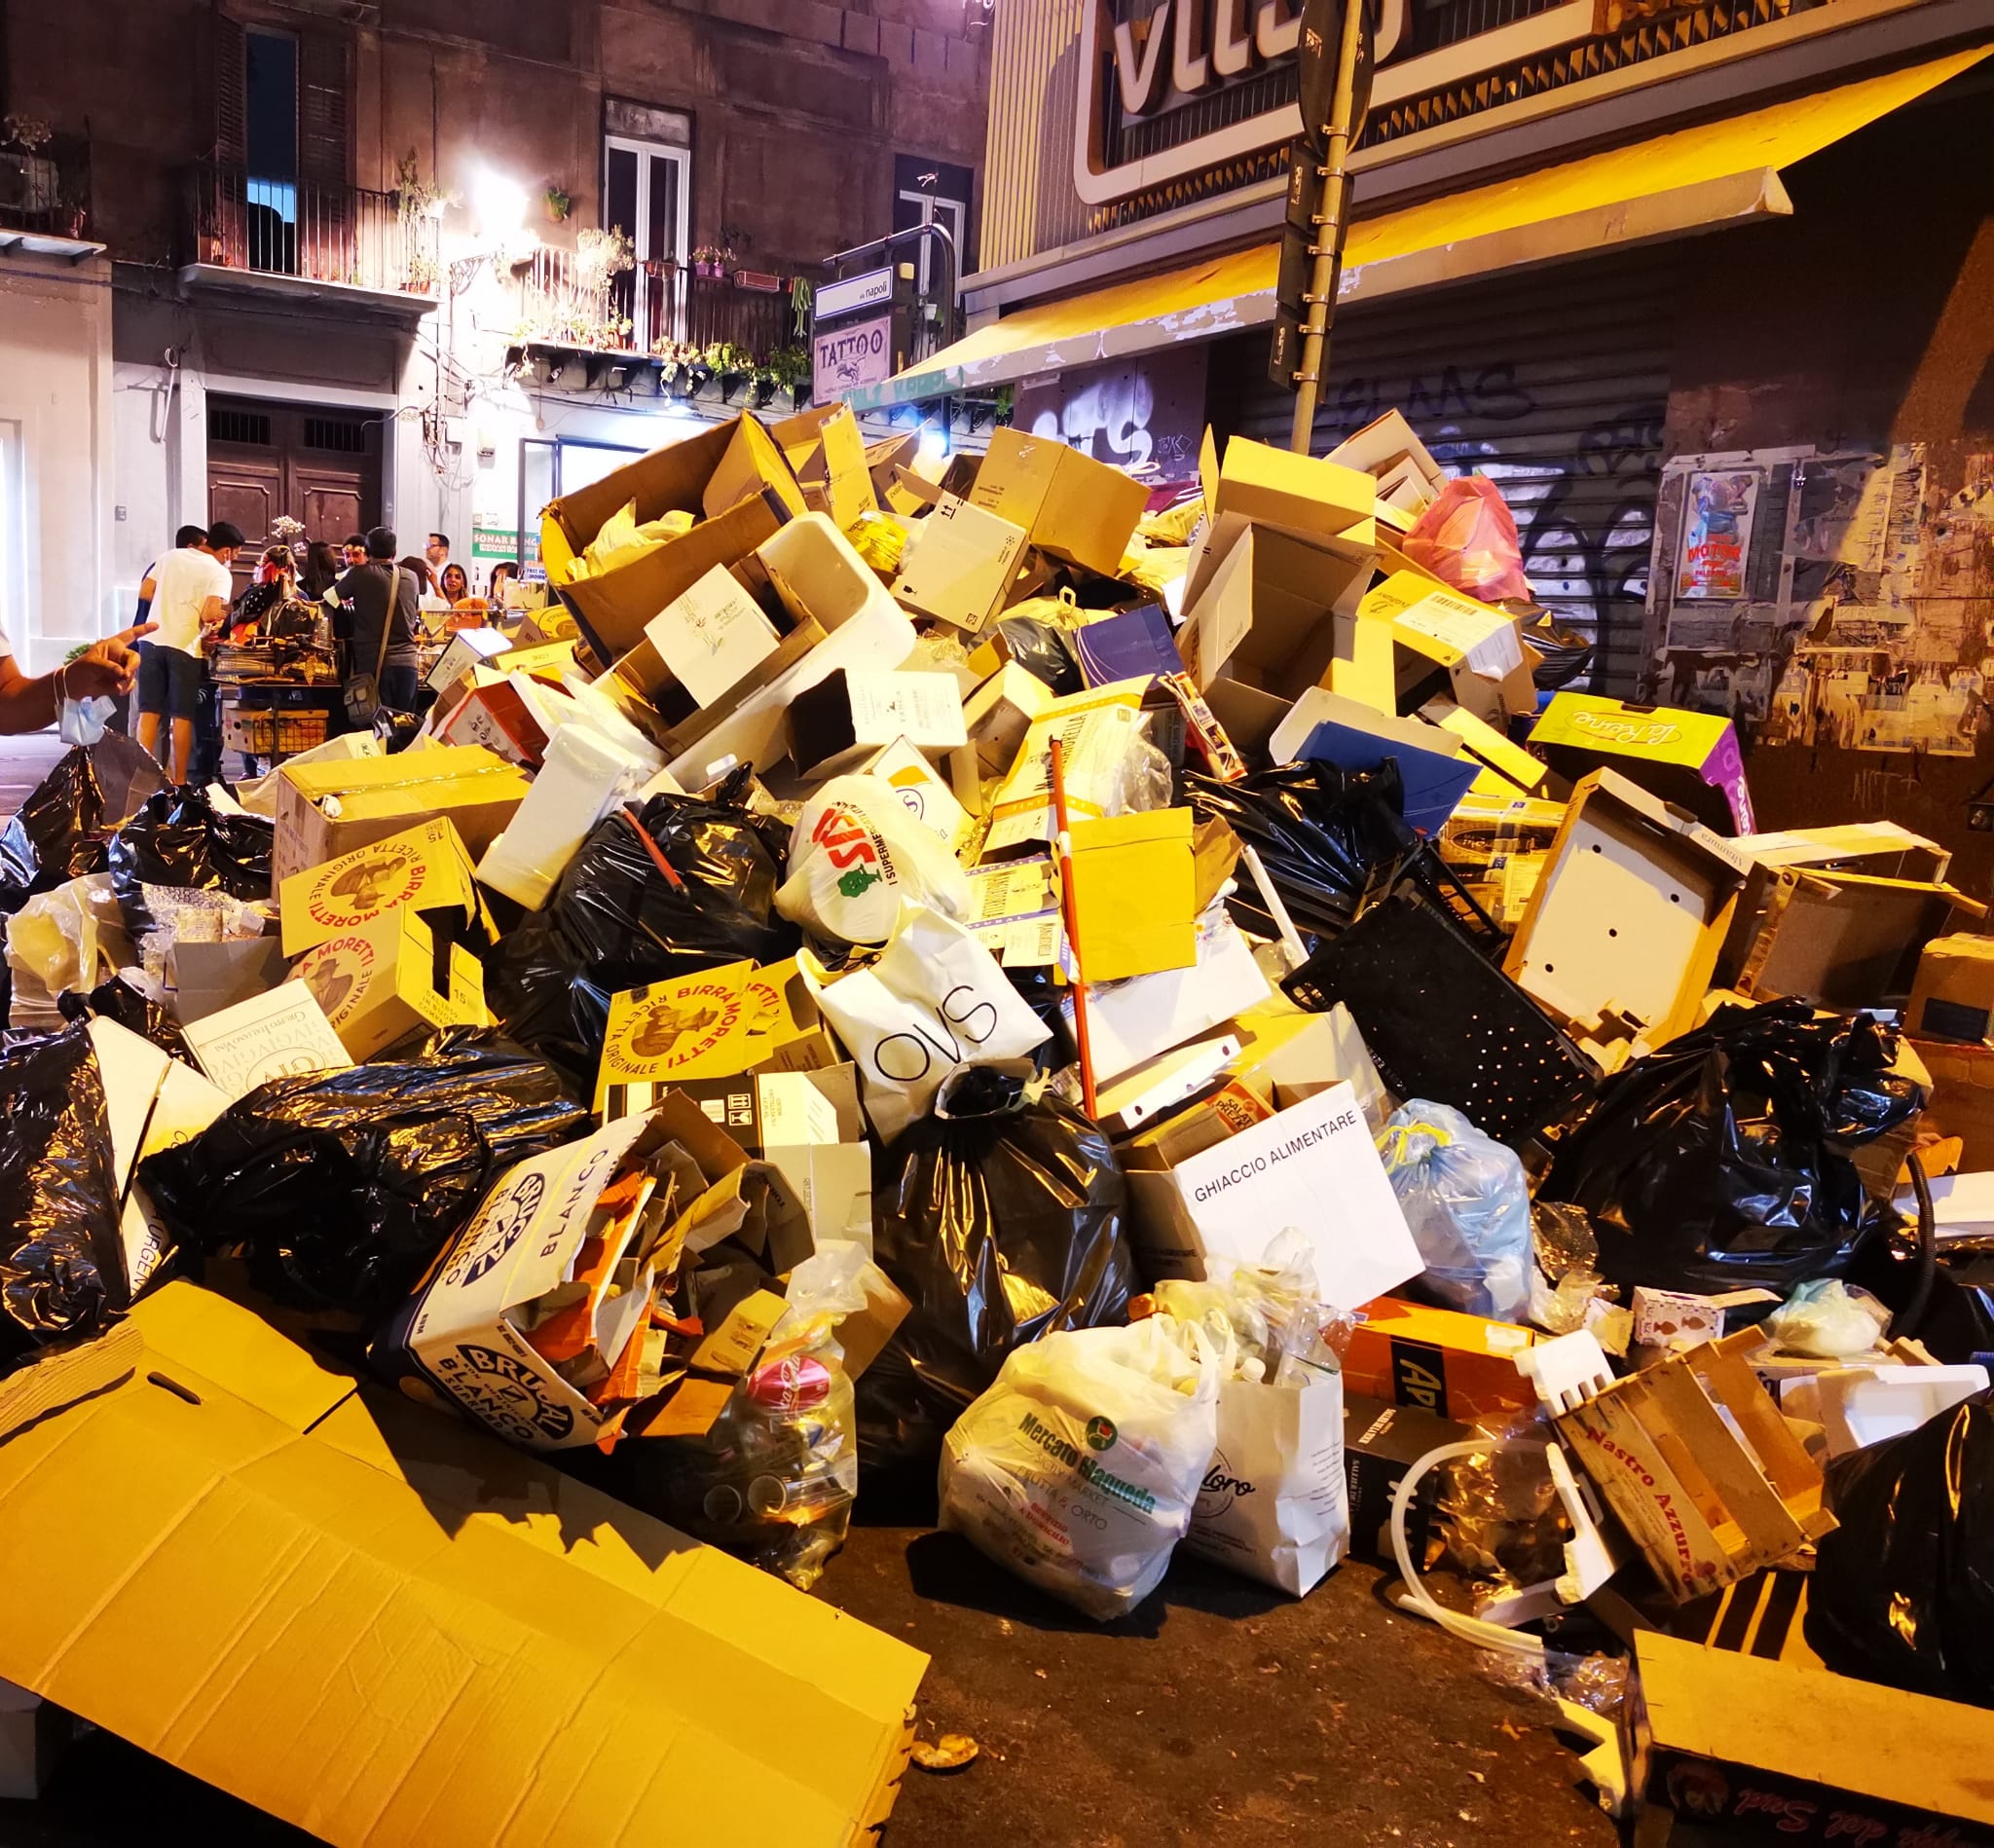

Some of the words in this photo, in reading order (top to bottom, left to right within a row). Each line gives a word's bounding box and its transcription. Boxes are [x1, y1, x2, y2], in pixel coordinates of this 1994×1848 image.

[866, 281, 887, 298] napoli
[820, 329, 883, 369] TATTOO
[474, 534, 505, 544] SONAR
[1687, 544, 1742, 563] MOTOR
[1572, 711, 1644, 743] Reine
[1647, 723, 1678, 745] La
[372, 843, 422, 864] RICETTA
[428, 832, 444, 843] 15
[309, 850, 366, 902] ORIGINALE
[384, 865, 426, 909] BIRRA
[309, 902, 380, 929] MORETTI
[316, 937, 375, 967] MORETTI
[454, 989, 467, 1005] 15
[678, 984, 737, 1003] BIRRA
[747, 982, 780, 1007] ETTI
[610, 995, 668, 1042] RICETTA
[668, 1001, 742, 1069] MORETTI
[874, 985, 997, 1082] OVS
[606, 1044, 660, 1075] ORIGINALE
[1217, 1101, 1247, 1130] PREZIO
[1225, 1098, 1253, 1126] SALAT
[1195, 1157, 1267, 1202] GHIACCIO
[1270, 1110, 1357, 1165] ALIMENTARE
[539, 1149, 609, 1258] BLANCO
[446, 1188, 510, 1286] BLANCO
[474, 1174, 543, 1276] BRUGAL
[130, 1223, 165, 1297] URGEN
[438, 1357, 535, 1439] BLANCO
[1399, 1357, 1442, 1409] AP
[1018, 1412, 1079, 1468] Mercato
[1077, 1455, 1157, 1515] Maqueda
[1016, 1465, 1059, 1502] FRUTTA
[1059, 1496, 1069, 1509] &
[1071, 1504, 1108, 1531] ORTO
[1585, 1425, 1655, 1487] Nastro
[1653, 1494, 1693, 1586] Azzurro
[1733, 1788, 1818, 1832] Sud
